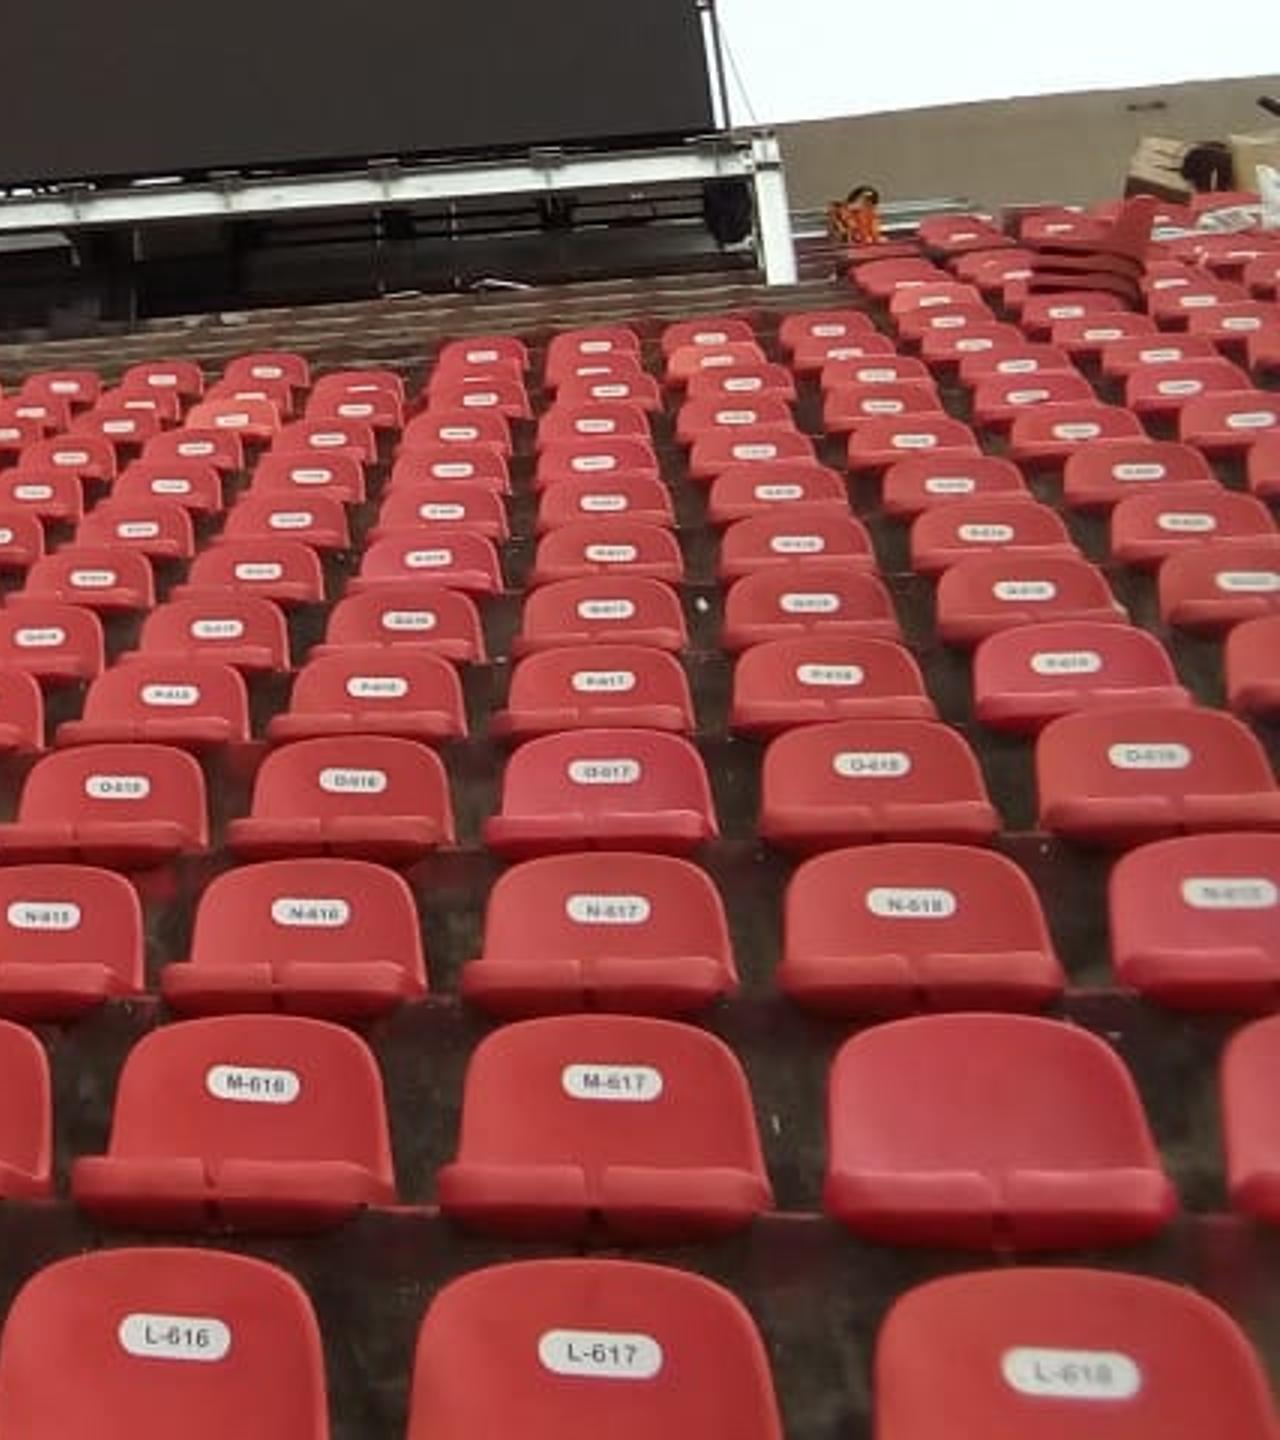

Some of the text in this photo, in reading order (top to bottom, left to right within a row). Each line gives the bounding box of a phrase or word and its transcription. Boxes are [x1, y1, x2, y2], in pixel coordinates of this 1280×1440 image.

[227, 1073, 285, 1093] M-616
[583, 1072, 647, 1091] M-617
[144, 1325, 209, 1349] L-616
[567, 1342, 638, 1365] L-617
